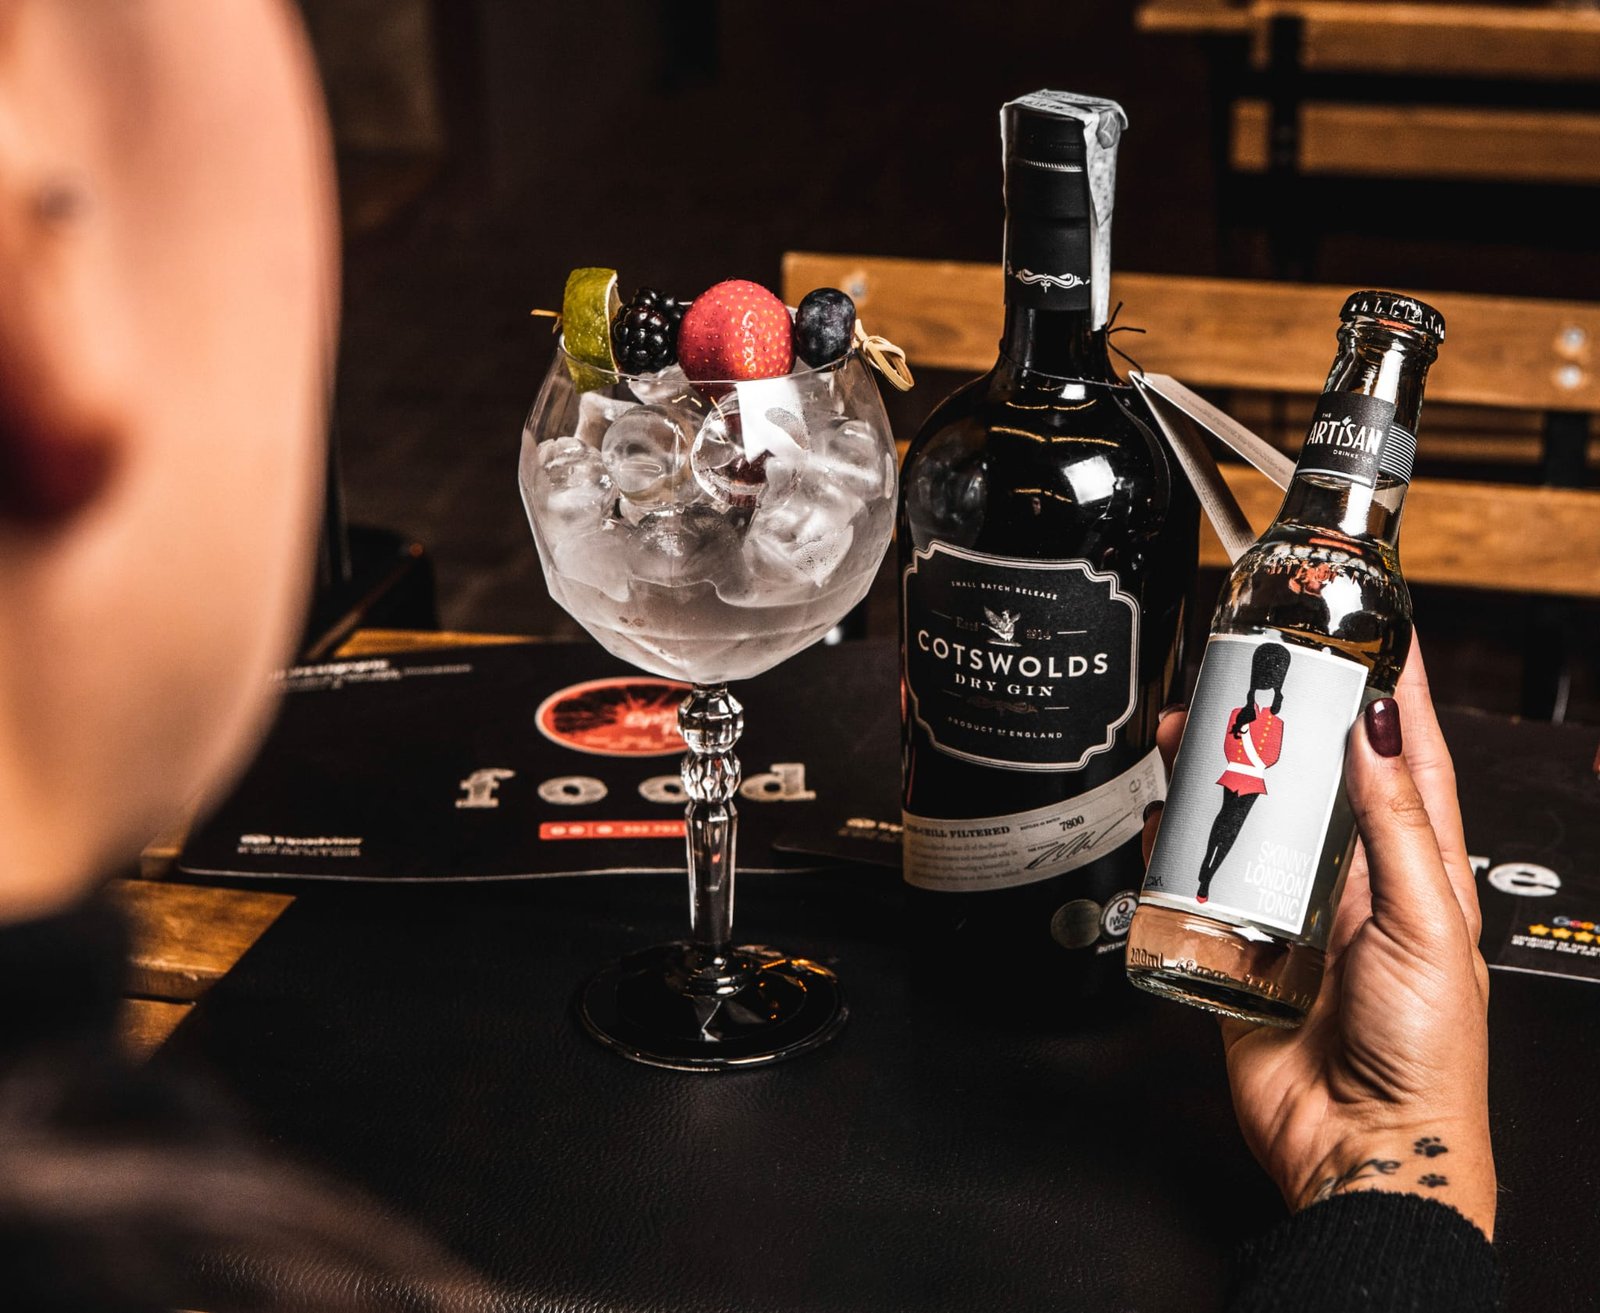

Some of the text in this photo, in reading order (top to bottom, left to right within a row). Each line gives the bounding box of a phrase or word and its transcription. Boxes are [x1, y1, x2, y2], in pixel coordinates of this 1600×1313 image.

[1333, 449, 1359, 459] DRINKS
[951, 581, 1058, 601] SMALL BATCH RELEASE
[917, 629, 1109, 679] COTSWOLDS
[954, 673, 1055, 698] DRY GIN
[947, 716, 994, 735] PRODUCT
[1009, 731, 1064, 740] ENGLAND
[948, 826, 1011, 839] FILTERED
[1059, 815, 1085, 831] 7800
[1258, 840, 1312, 876] SKINNY
[1244, 860, 1307, 898] LONDON
[1257, 887, 1300, 920] TONIC
